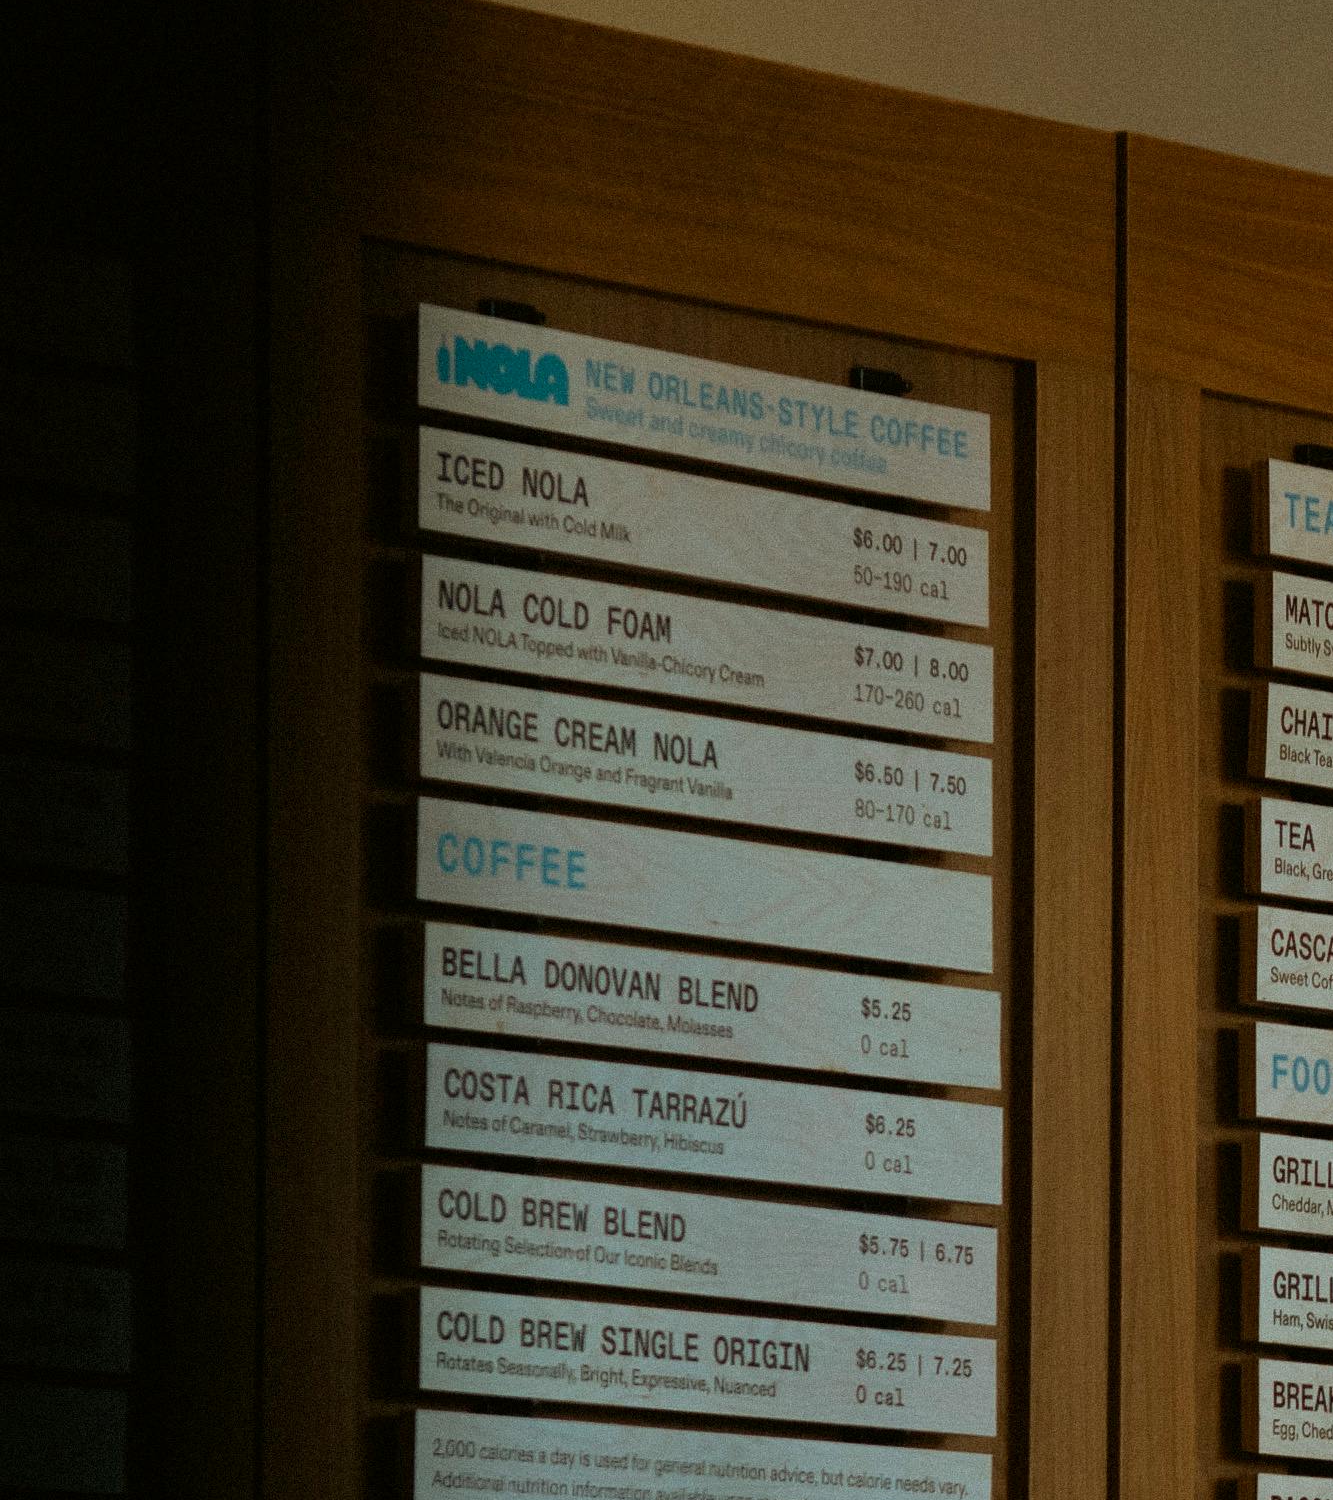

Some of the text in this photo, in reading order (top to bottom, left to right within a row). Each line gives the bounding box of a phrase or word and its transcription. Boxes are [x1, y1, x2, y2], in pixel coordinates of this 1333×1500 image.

[456, 336, 570, 408] NOLA
[584, 358, 636, 394] NEW
[869, 415, 968, 458] COFFEE
[436, 451, 589, 506] ICED NOLA
[852, 526, 968, 567] $6.00 7.00
[437, 580, 671, 642] NOLA COLD FOAM
[853, 644, 969, 682] $7.00 8.00
[436, 699, 718, 768] ORANGE CREAM NOLA
[1279, 705, 1333, 741] CHAI
[1278, 743, 1311, 764] Black
[853, 759, 967, 796] $6.50 7.50
[1273, 819, 1315, 851] TEA
[436, 833, 586, 889] COFFEE
[1273, 856, 1310, 881] Black,
[441, 946, 759, 1012] BELLA DONOVAN BLEND
[1269, 965, 1309, 987] Sweet
[860, 996, 911, 1022] $5.25
[443, 1068, 747, 1128] COSTA RICA TARRAZÚ
[864, 1112, 916, 1138] $6.25
[437, 1188, 686, 1242] COLD BREW BLEND
[1271, 1192, 1324, 1216] Cheddar,
[858, 1232, 974, 1266] $5.75 6.75
[1272, 1309, 1304, 1330] Ham,
[436, 1310, 810, 1371] COLD BREW SINGLE ORIGIN
[855, 1347, 972, 1378] $6.25 7.25
[1271, 1418, 1299, 1441] Egg,
